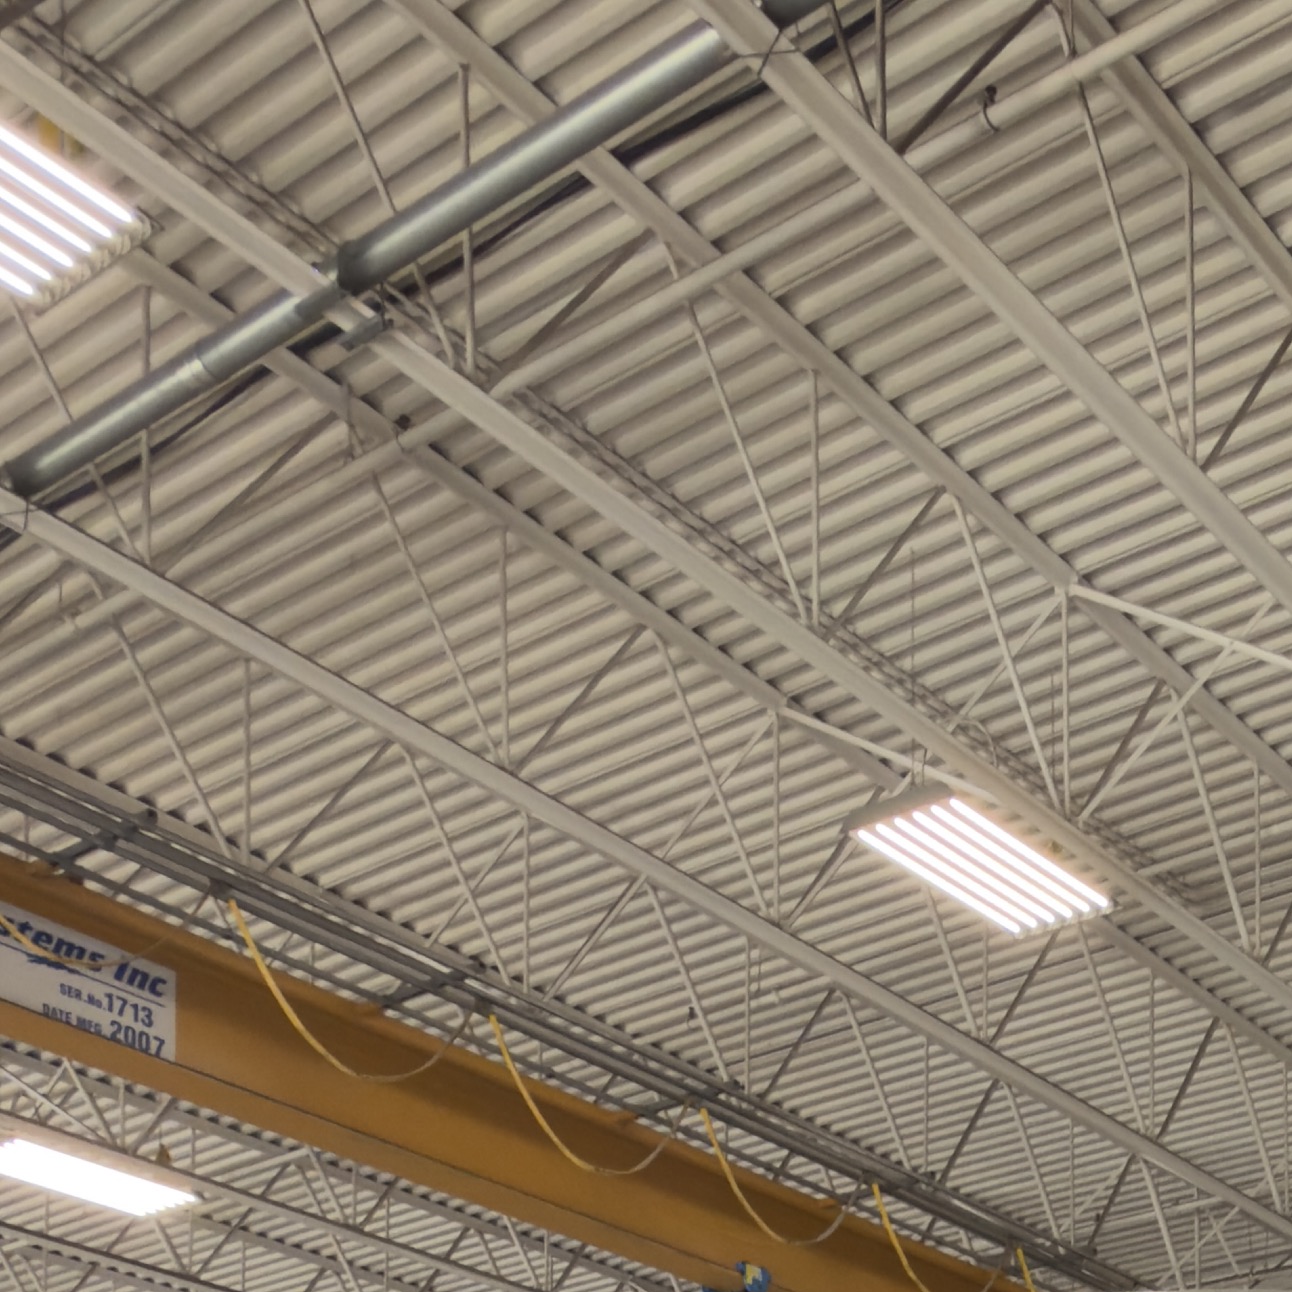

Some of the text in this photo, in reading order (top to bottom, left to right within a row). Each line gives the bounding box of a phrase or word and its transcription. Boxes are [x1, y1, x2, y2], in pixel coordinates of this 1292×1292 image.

[42, 1002, 73, 1025] DATE
[110, 1019, 165, 1057] 2007
[104, 992, 154, 1028] 1713
